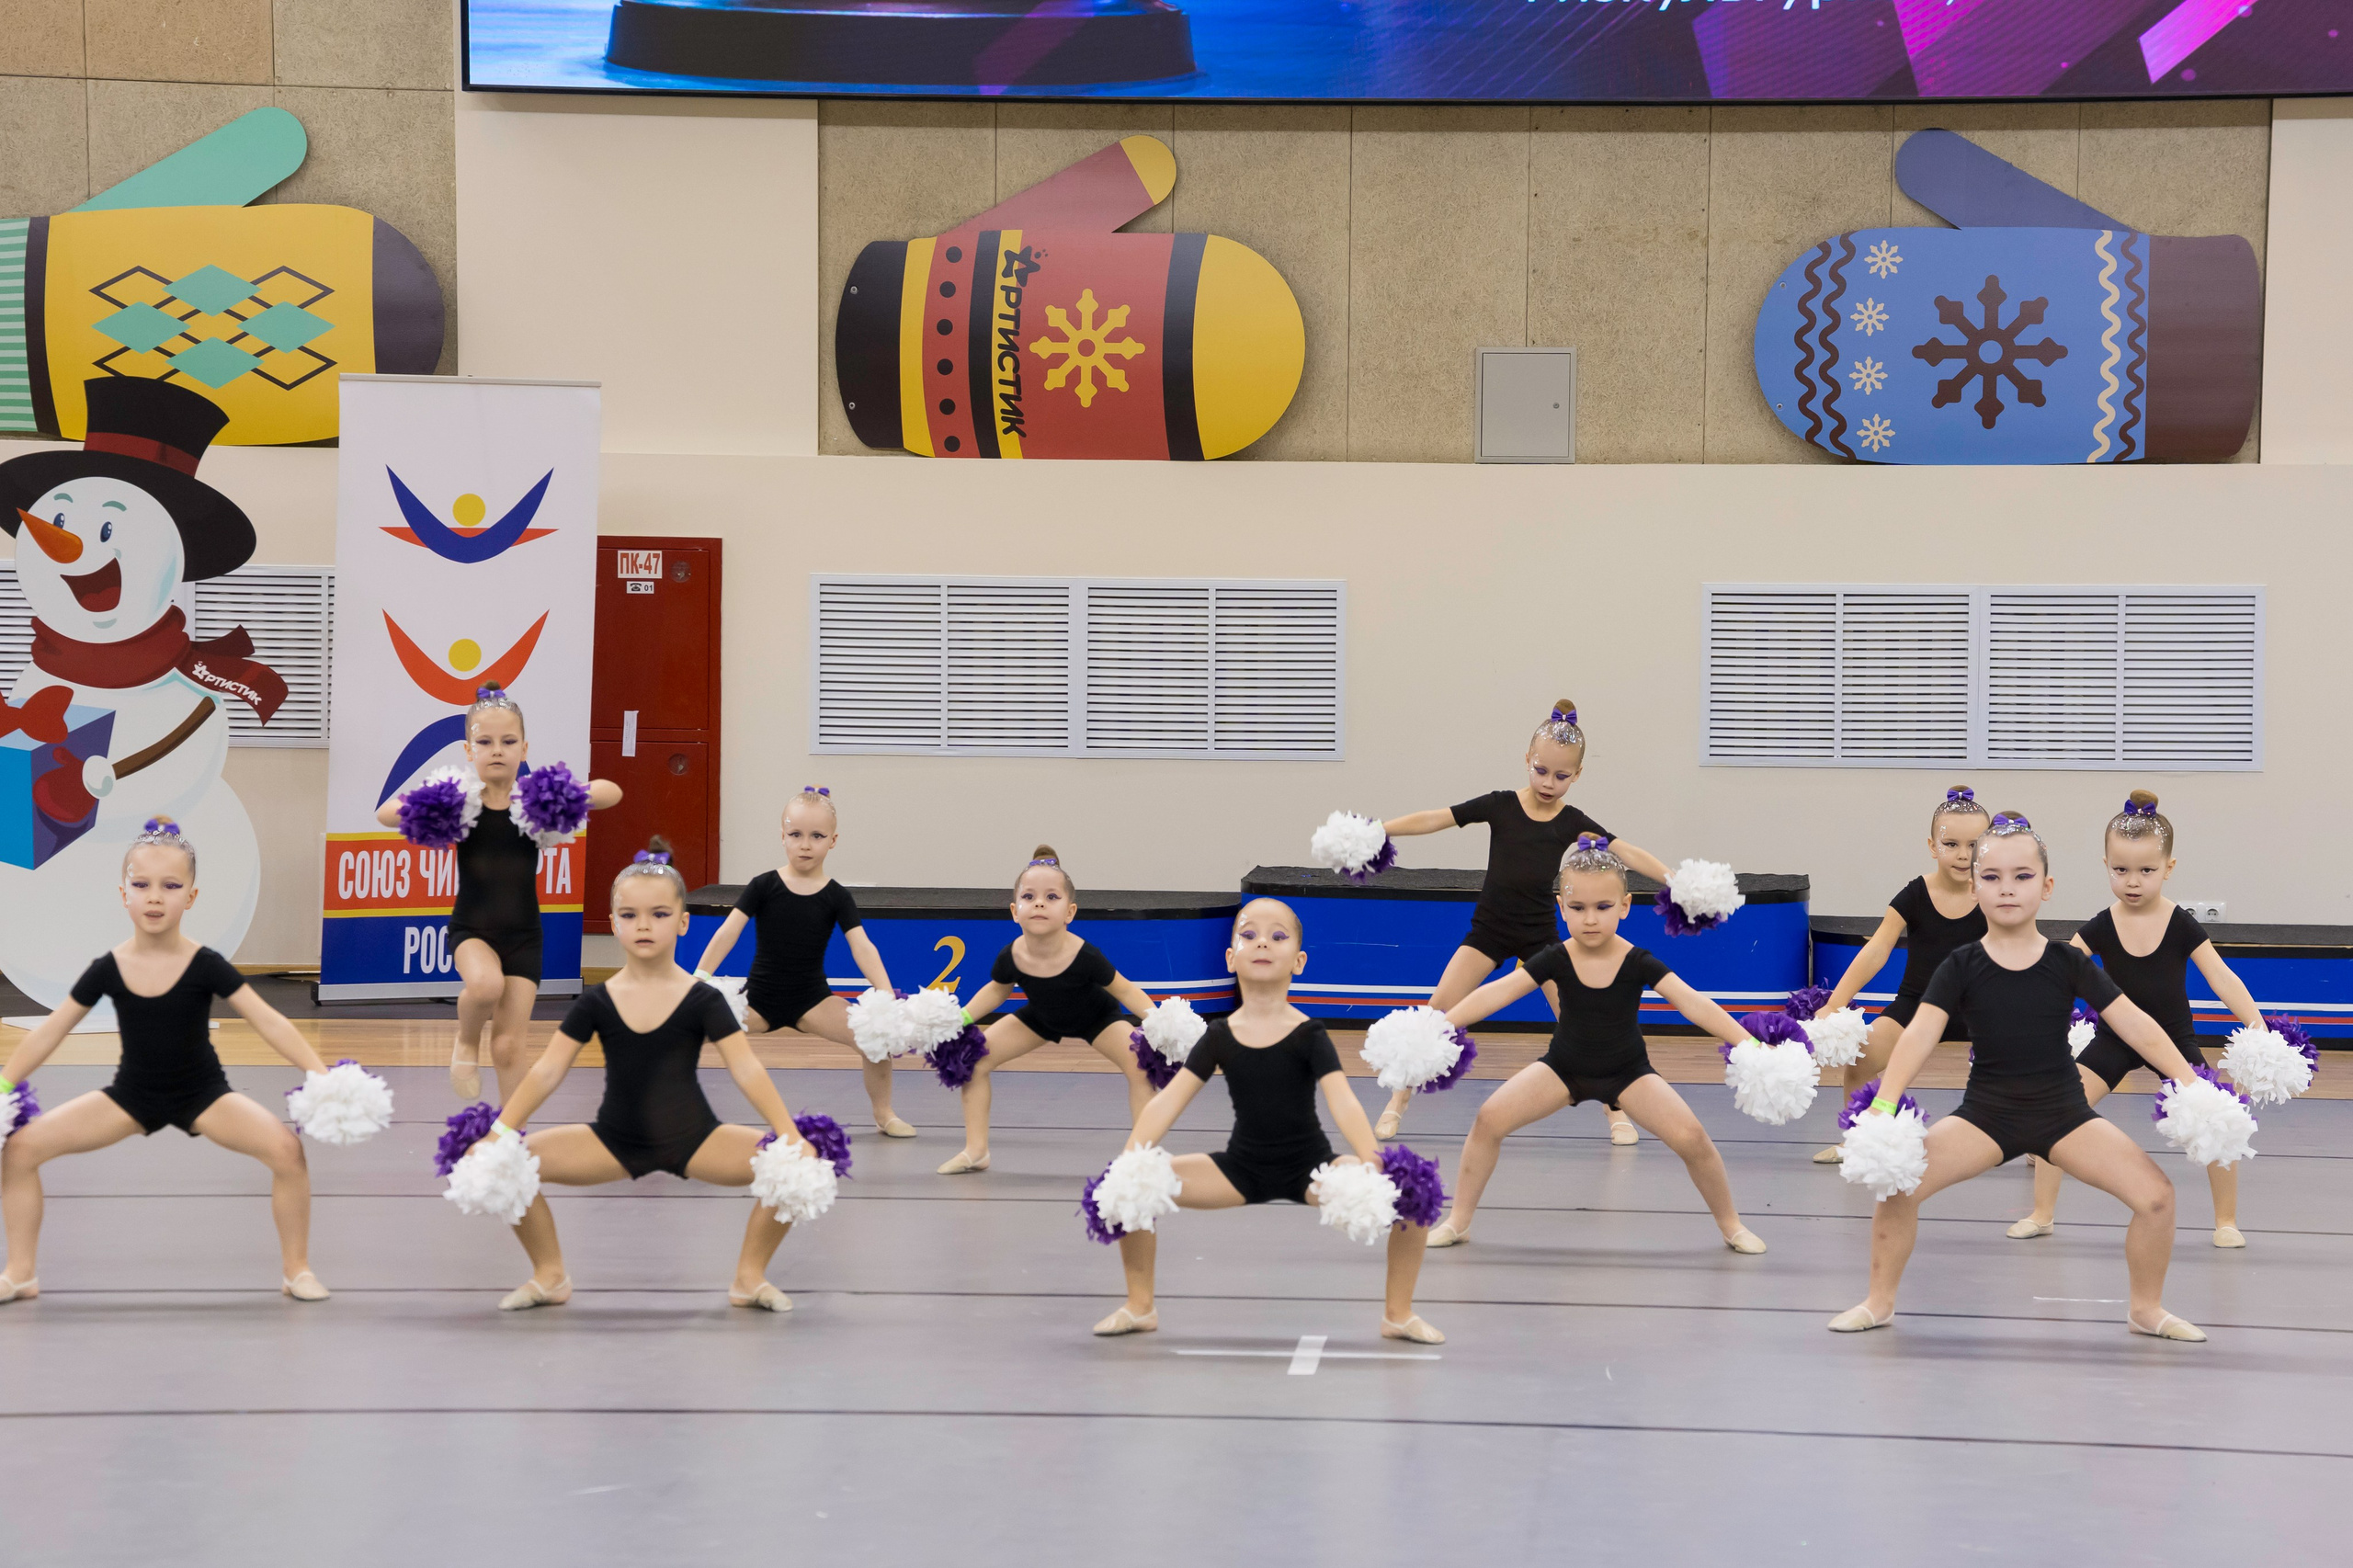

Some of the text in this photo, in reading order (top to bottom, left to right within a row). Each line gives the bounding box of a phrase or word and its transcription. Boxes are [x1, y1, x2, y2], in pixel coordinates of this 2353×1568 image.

[620, 552, 661, 574] ПК-47
[337, 848, 412, 900] СОЮЗ
[403, 925, 453, 974] РОС
[926, 935, 966, 994] 2
